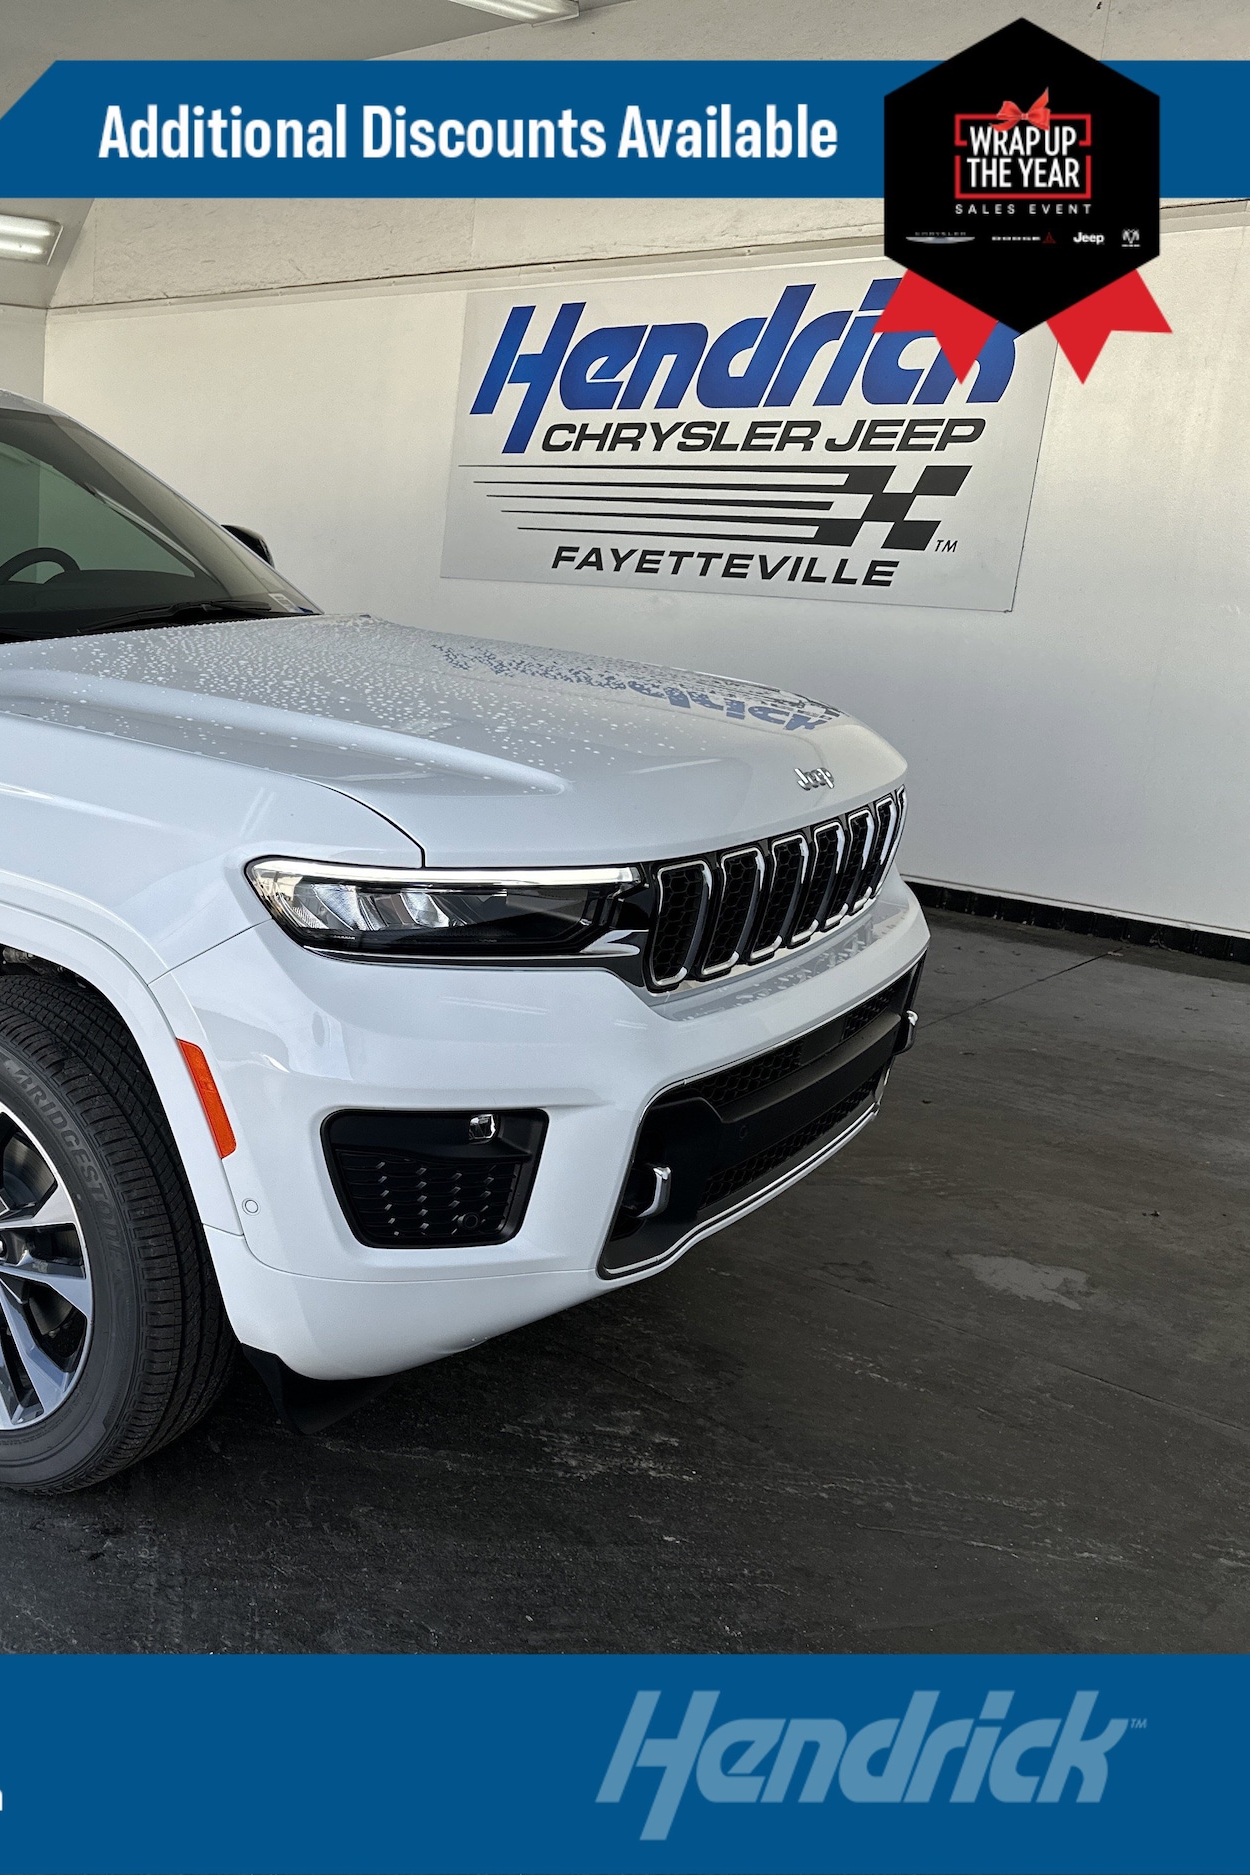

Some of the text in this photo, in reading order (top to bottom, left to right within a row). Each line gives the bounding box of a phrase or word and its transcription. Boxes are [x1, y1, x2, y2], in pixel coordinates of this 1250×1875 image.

[541, 417, 986, 453] CHRYSLER JEEP
[550, 545, 900, 587] FAYETTEVILLE
[794, 767, 835, 791] Jeep
[7, 1060, 126, 1262] BRIDGESTONE
